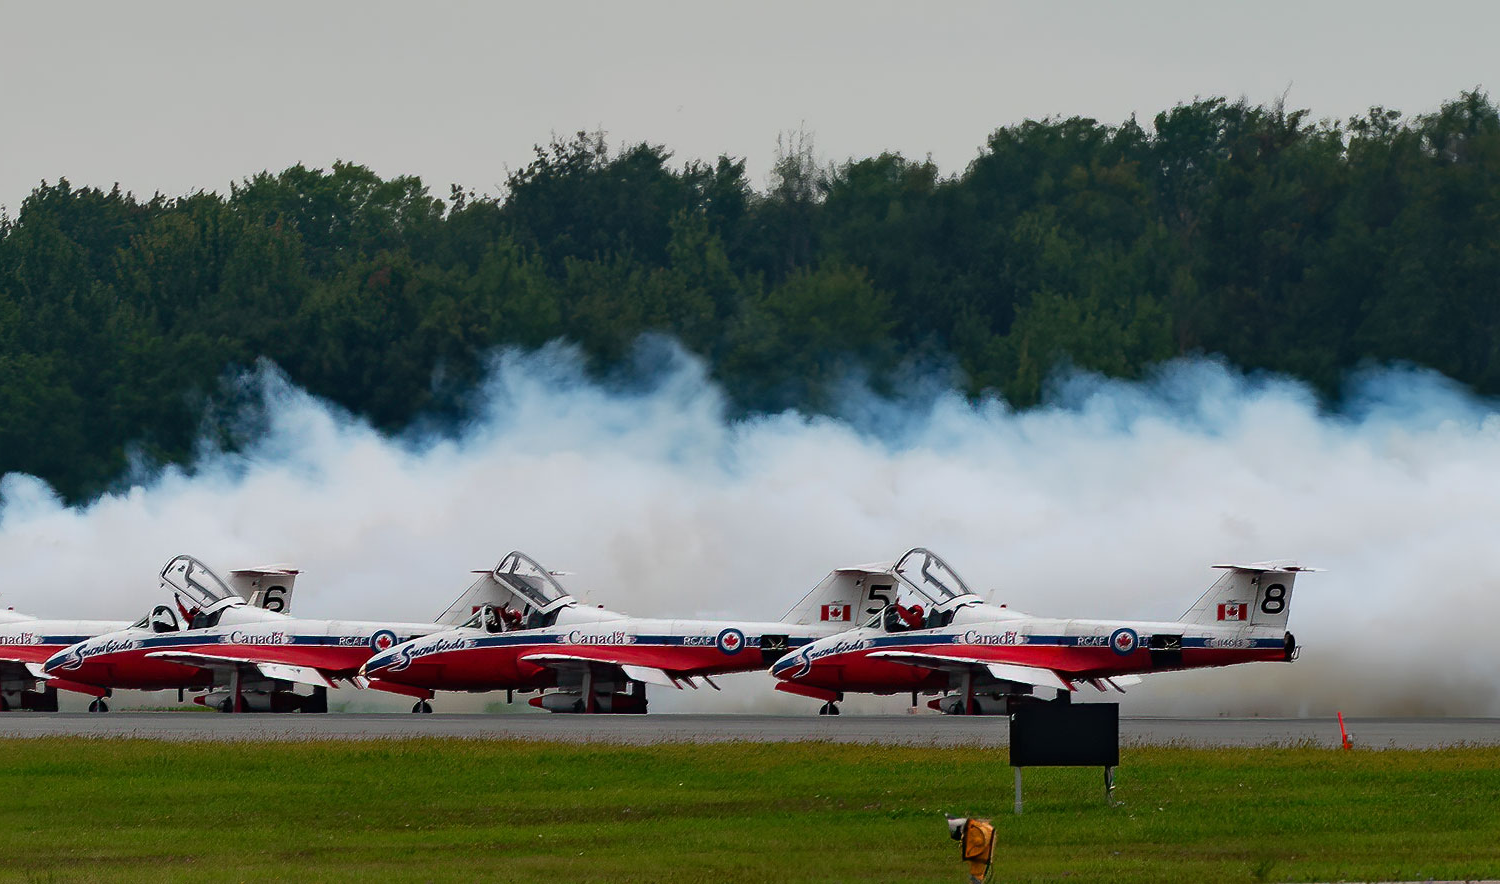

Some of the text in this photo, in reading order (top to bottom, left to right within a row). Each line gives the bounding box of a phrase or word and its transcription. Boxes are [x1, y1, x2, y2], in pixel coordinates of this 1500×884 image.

[262, 586, 287, 613] 6
[866, 585, 891, 615] 5
[1261, 583, 1286, 614] 8
[229, 631, 282, 645] Canada
[568, 631, 624, 645] Canada
[964, 629, 1017, 646] Canada
[62, 640, 134, 669] Snowbirds
[389, 638, 466, 672] Snowbirds
[792, 638, 865, 678] Snowbirds
